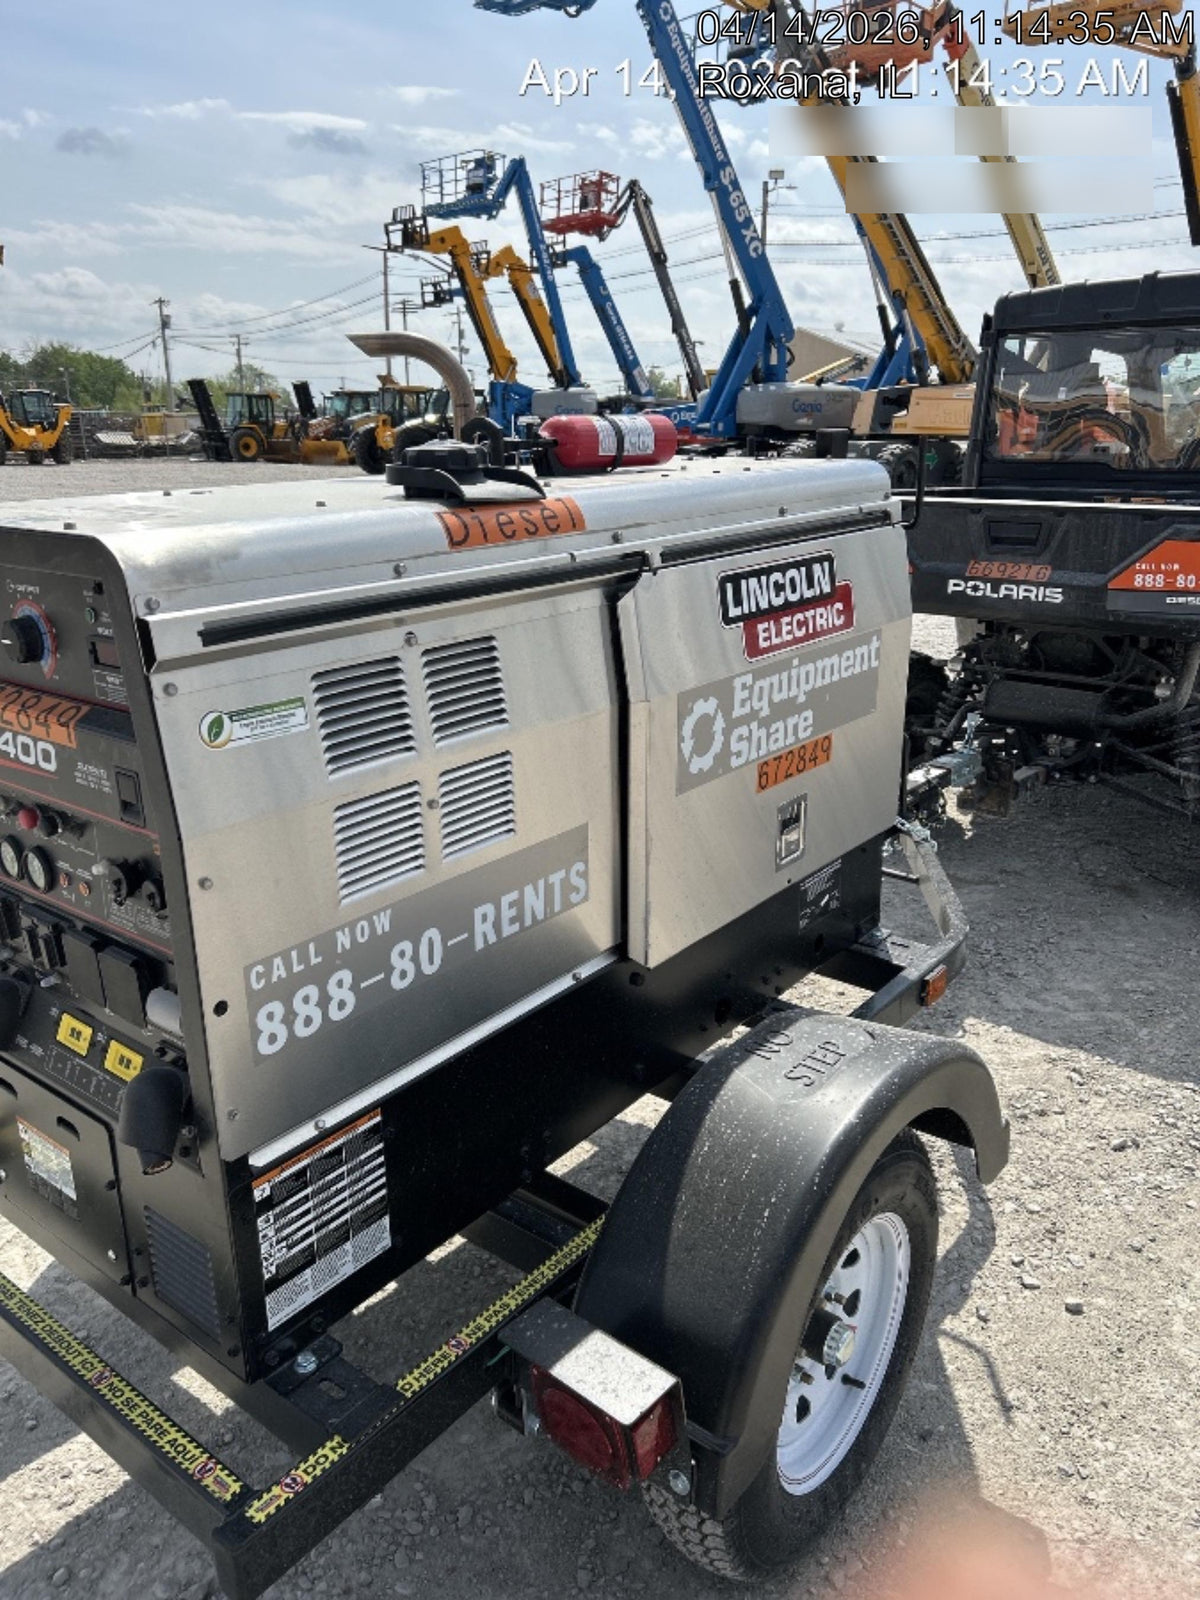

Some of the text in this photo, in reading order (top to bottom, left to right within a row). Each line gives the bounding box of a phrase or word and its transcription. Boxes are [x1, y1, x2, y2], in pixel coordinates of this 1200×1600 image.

[720, 165, 763, 255] S-65 XC
[436, 497, 577, 547] Diesel
[725, 561, 832, 618] LINCOLN
[947, 578, 1064, 604] POLARIS
[968, 560, 1049, 580] 669216
[1134, 573, 1200, 588] 888-80
[757, 602, 845, 650] ELECTRIC
[732, 634, 881, 718] Equipment
[0, 686, 82, 745] 2849
[730, 708, 814, 769] Share
[0, 731, 58, 773] 400
[757, 735, 832, 791] 672849
[249, 908, 392, 991] CALL NOW
[255, 861, 589, 1056] 888-80-RENTS
[784, 1041, 847, 1088] STEP
[41, 1323, 84, 1360] DEBOUT
[104, 1381, 125, 1399] NO
[121, 1396, 142, 1413] SE
[137, 1410, 172, 1440] PARE
[302, 1453, 330, 1476] DO
